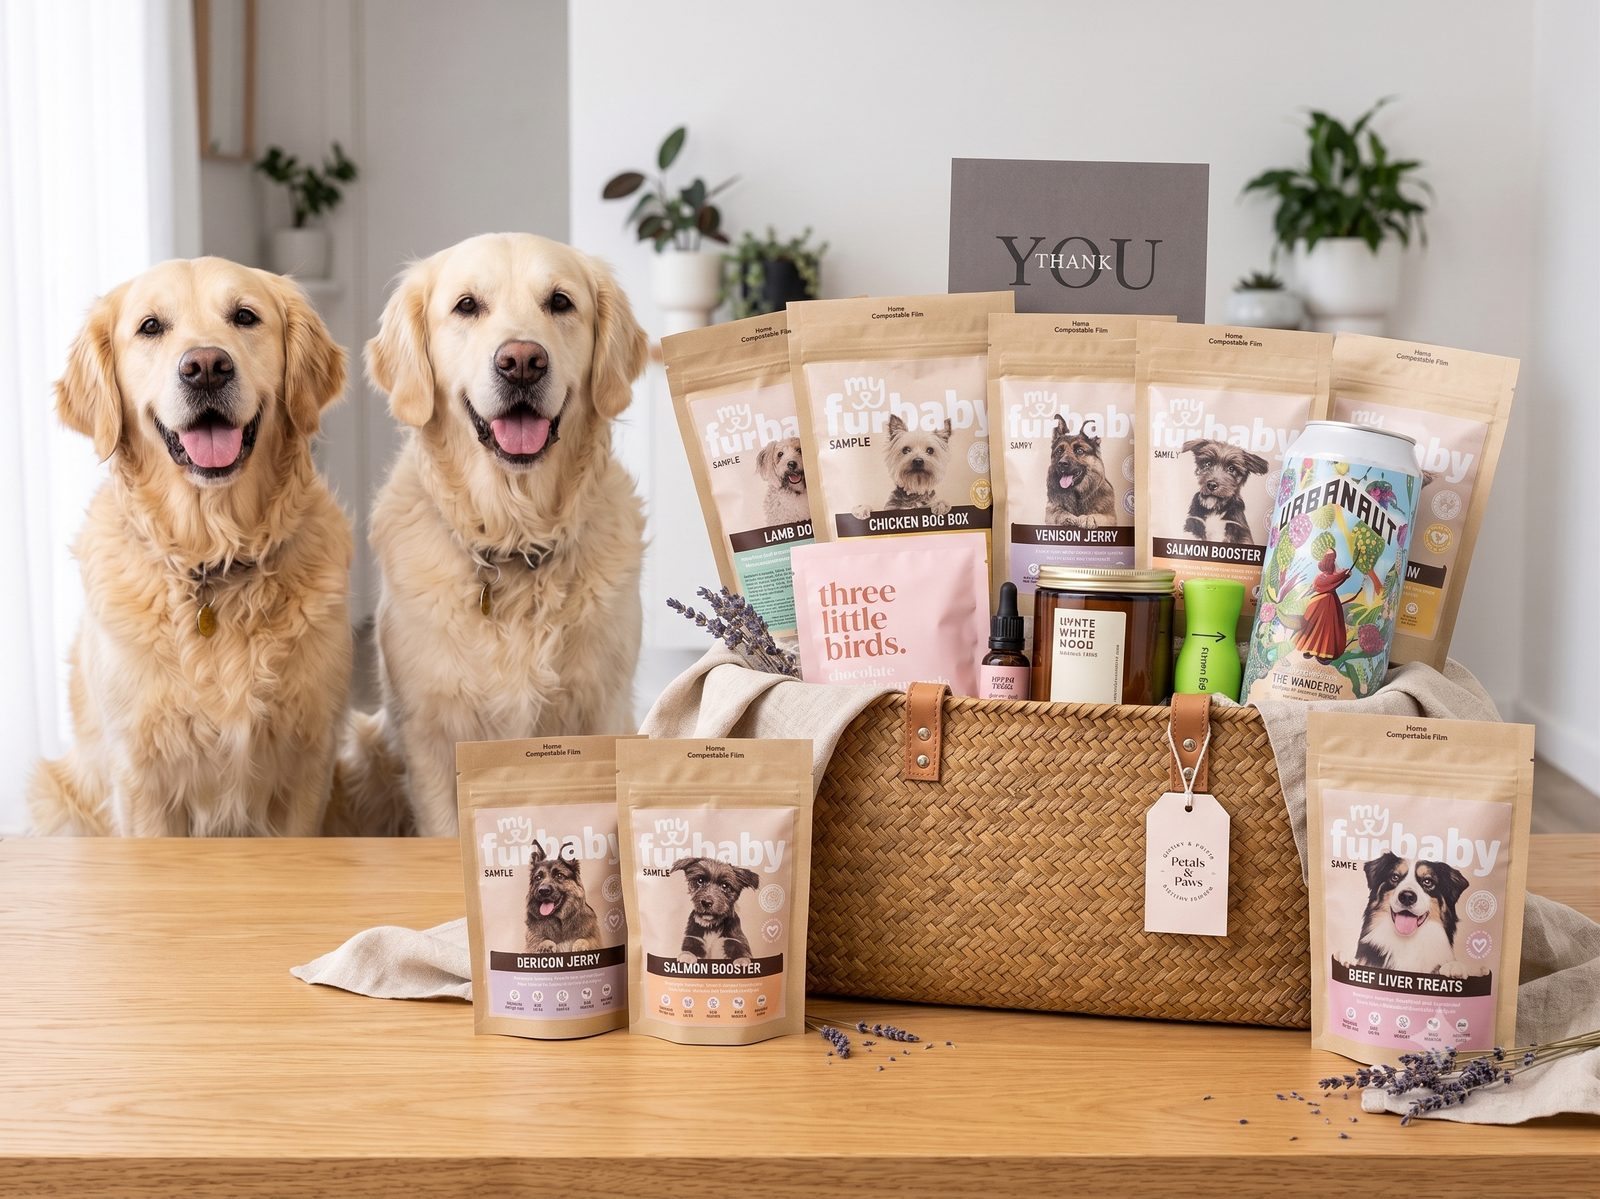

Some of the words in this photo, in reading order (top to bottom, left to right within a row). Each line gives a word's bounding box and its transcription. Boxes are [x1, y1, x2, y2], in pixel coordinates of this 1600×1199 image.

[995, 235, 1163, 290] YOU
[1034, 253, 1112, 270] THANK
[844, 376, 885, 410] my
[1024, 390, 1058, 417] my
[717, 403, 752, 433] my
[1169, 397, 1204, 426] my
[705, 413, 800, 458] furba
[829, 437, 871, 450] SAMPLE
[869, 516, 919, 531] CHICKEN
[921, 514, 945, 527] BOG
[947, 512, 969, 526] BOX
[1279, 478, 1397, 546] URBANAUT
[764, 527, 796, 543] LAMB
[1035, 529, 1081, 542] VENISON
[1083, 530, 1118, 543] JERRY
[1166, 543, 1209, 557] SALMON
[1211, 547, 1261, 562] BOOSTER
[818, 581, 896, 607] three
[822, 606, 888, 634] little
[1059, 627, 1096, 639] WHITE
[824, 632, 907, 661] birds.
[828, 665, 896, 681] chocolate
[1272, 672, 1289, 685] THE
[497, 816, 532, 844] my
[654, 817, 689, 846] my
[1350, 803, 1390, 837] my
[639, 832, 786, 873] furbaby
[1331, 819, 1501, 877] furbaby
[1171, 856, 1206, 868] Petals
[1183, 868, 1194, 877] &
[1175, 876, 1203, 887] Paws
[517, 955, 564, 969] DERICON
[566, 952, 601, 968] JERRY
[663, 961, 709, 975] SALMON
[711, 962, 761, 975] BOOSTER
[1348, 968, 1376, 984] BEEF
[1378, 972, 1413, 990] LIVER
[1416, 976, 1464, 993] TREATS
